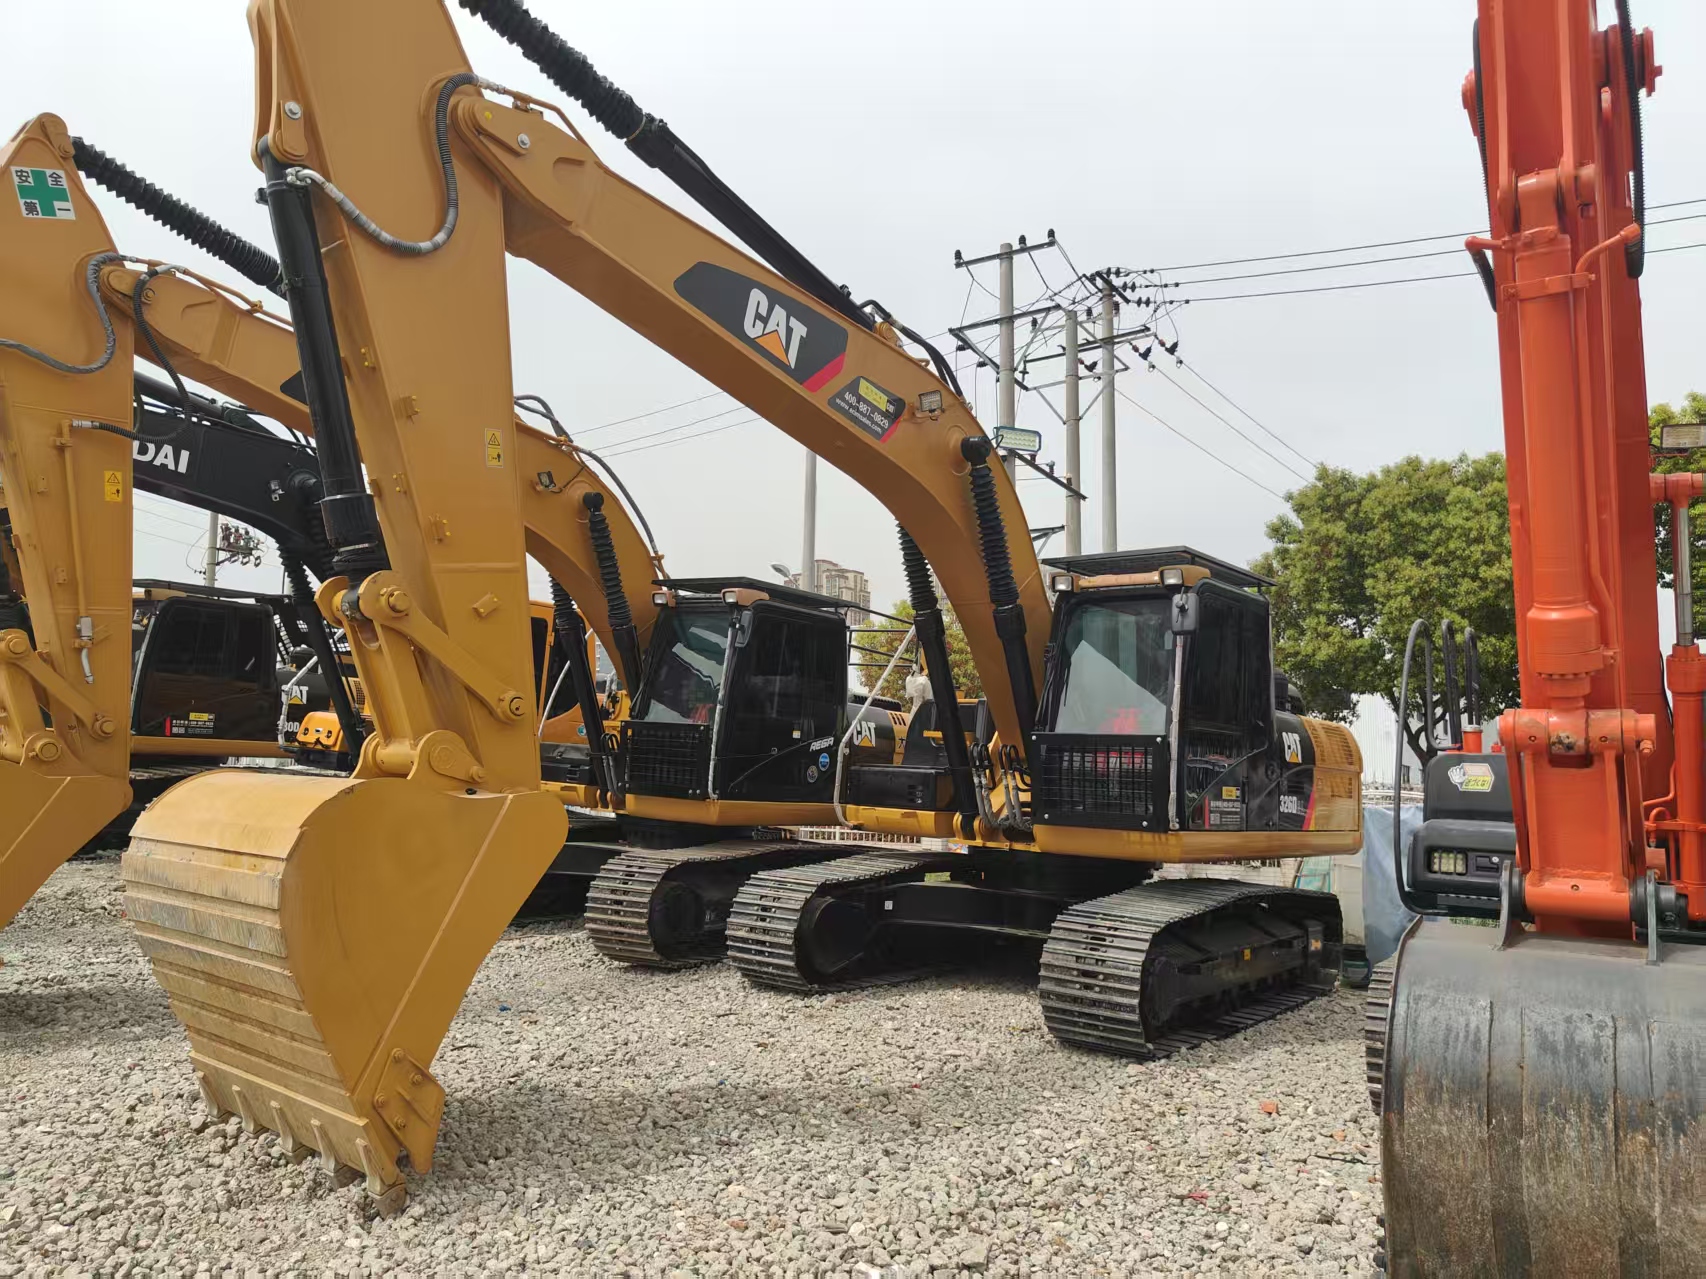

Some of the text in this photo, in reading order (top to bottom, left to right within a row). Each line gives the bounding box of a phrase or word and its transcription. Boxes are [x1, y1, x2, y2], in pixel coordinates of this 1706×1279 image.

[15, 169, 64, 187] 安全
[23, 200, 71, 217] 第一
[744, 288, 807, 369] CAT
[844, 391, 889, 429] 400-887-0829
[852, 720, 876, 747] CAT
[1282, 731, 1302, 763] CAT
[1279, 795, 1298, 814] 326D
